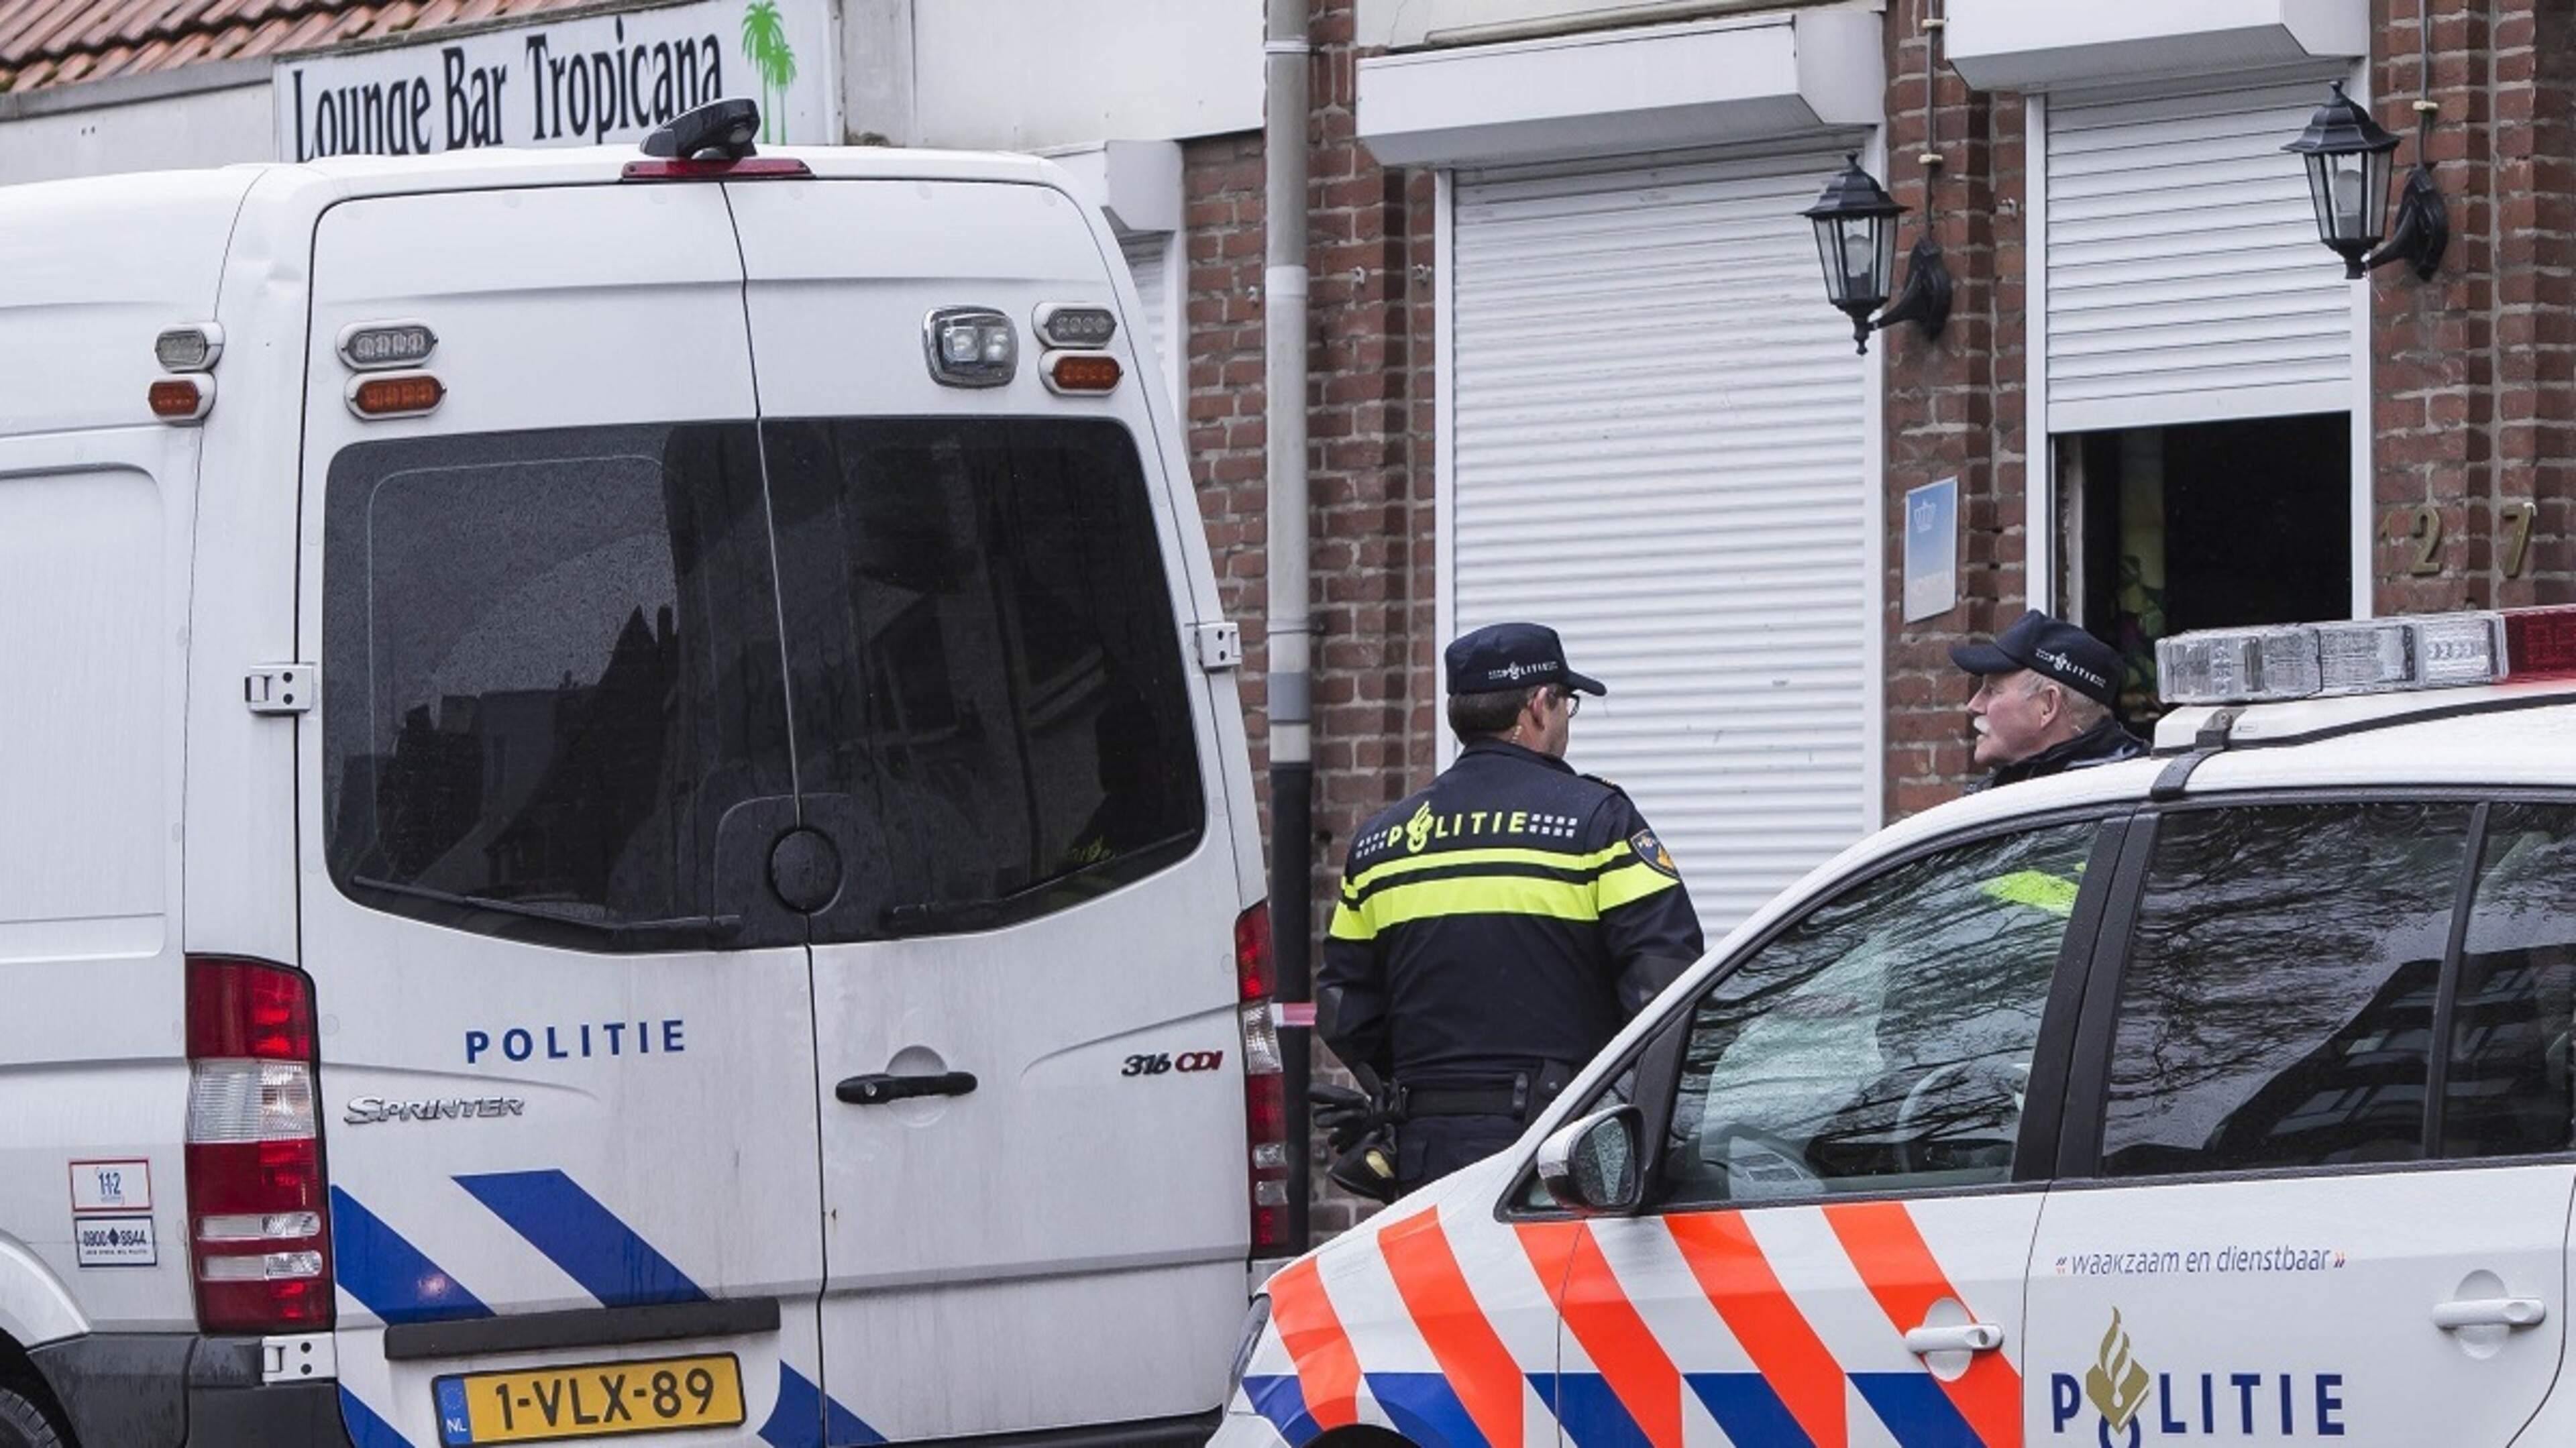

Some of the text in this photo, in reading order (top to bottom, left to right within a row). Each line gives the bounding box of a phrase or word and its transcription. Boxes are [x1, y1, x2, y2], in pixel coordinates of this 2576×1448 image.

[293, 14, 722, 163] Lounge Bar Tropicana
[1387, 810, 1527, 852] POLITIE
[466, 1019, 685, 1064] POLITIE
[1120, 1050, 1223, 1076] 316 CDI
[2072, 1249, 2179, 1275] waakzaam
[2186, 1249, 2210, 1273] en
[2216, 1245, 2330, 1272] dienstbaar
[496, 1368, 714, 1431] 1-VLX-89
[446, 1417, 467, 1433] NL
